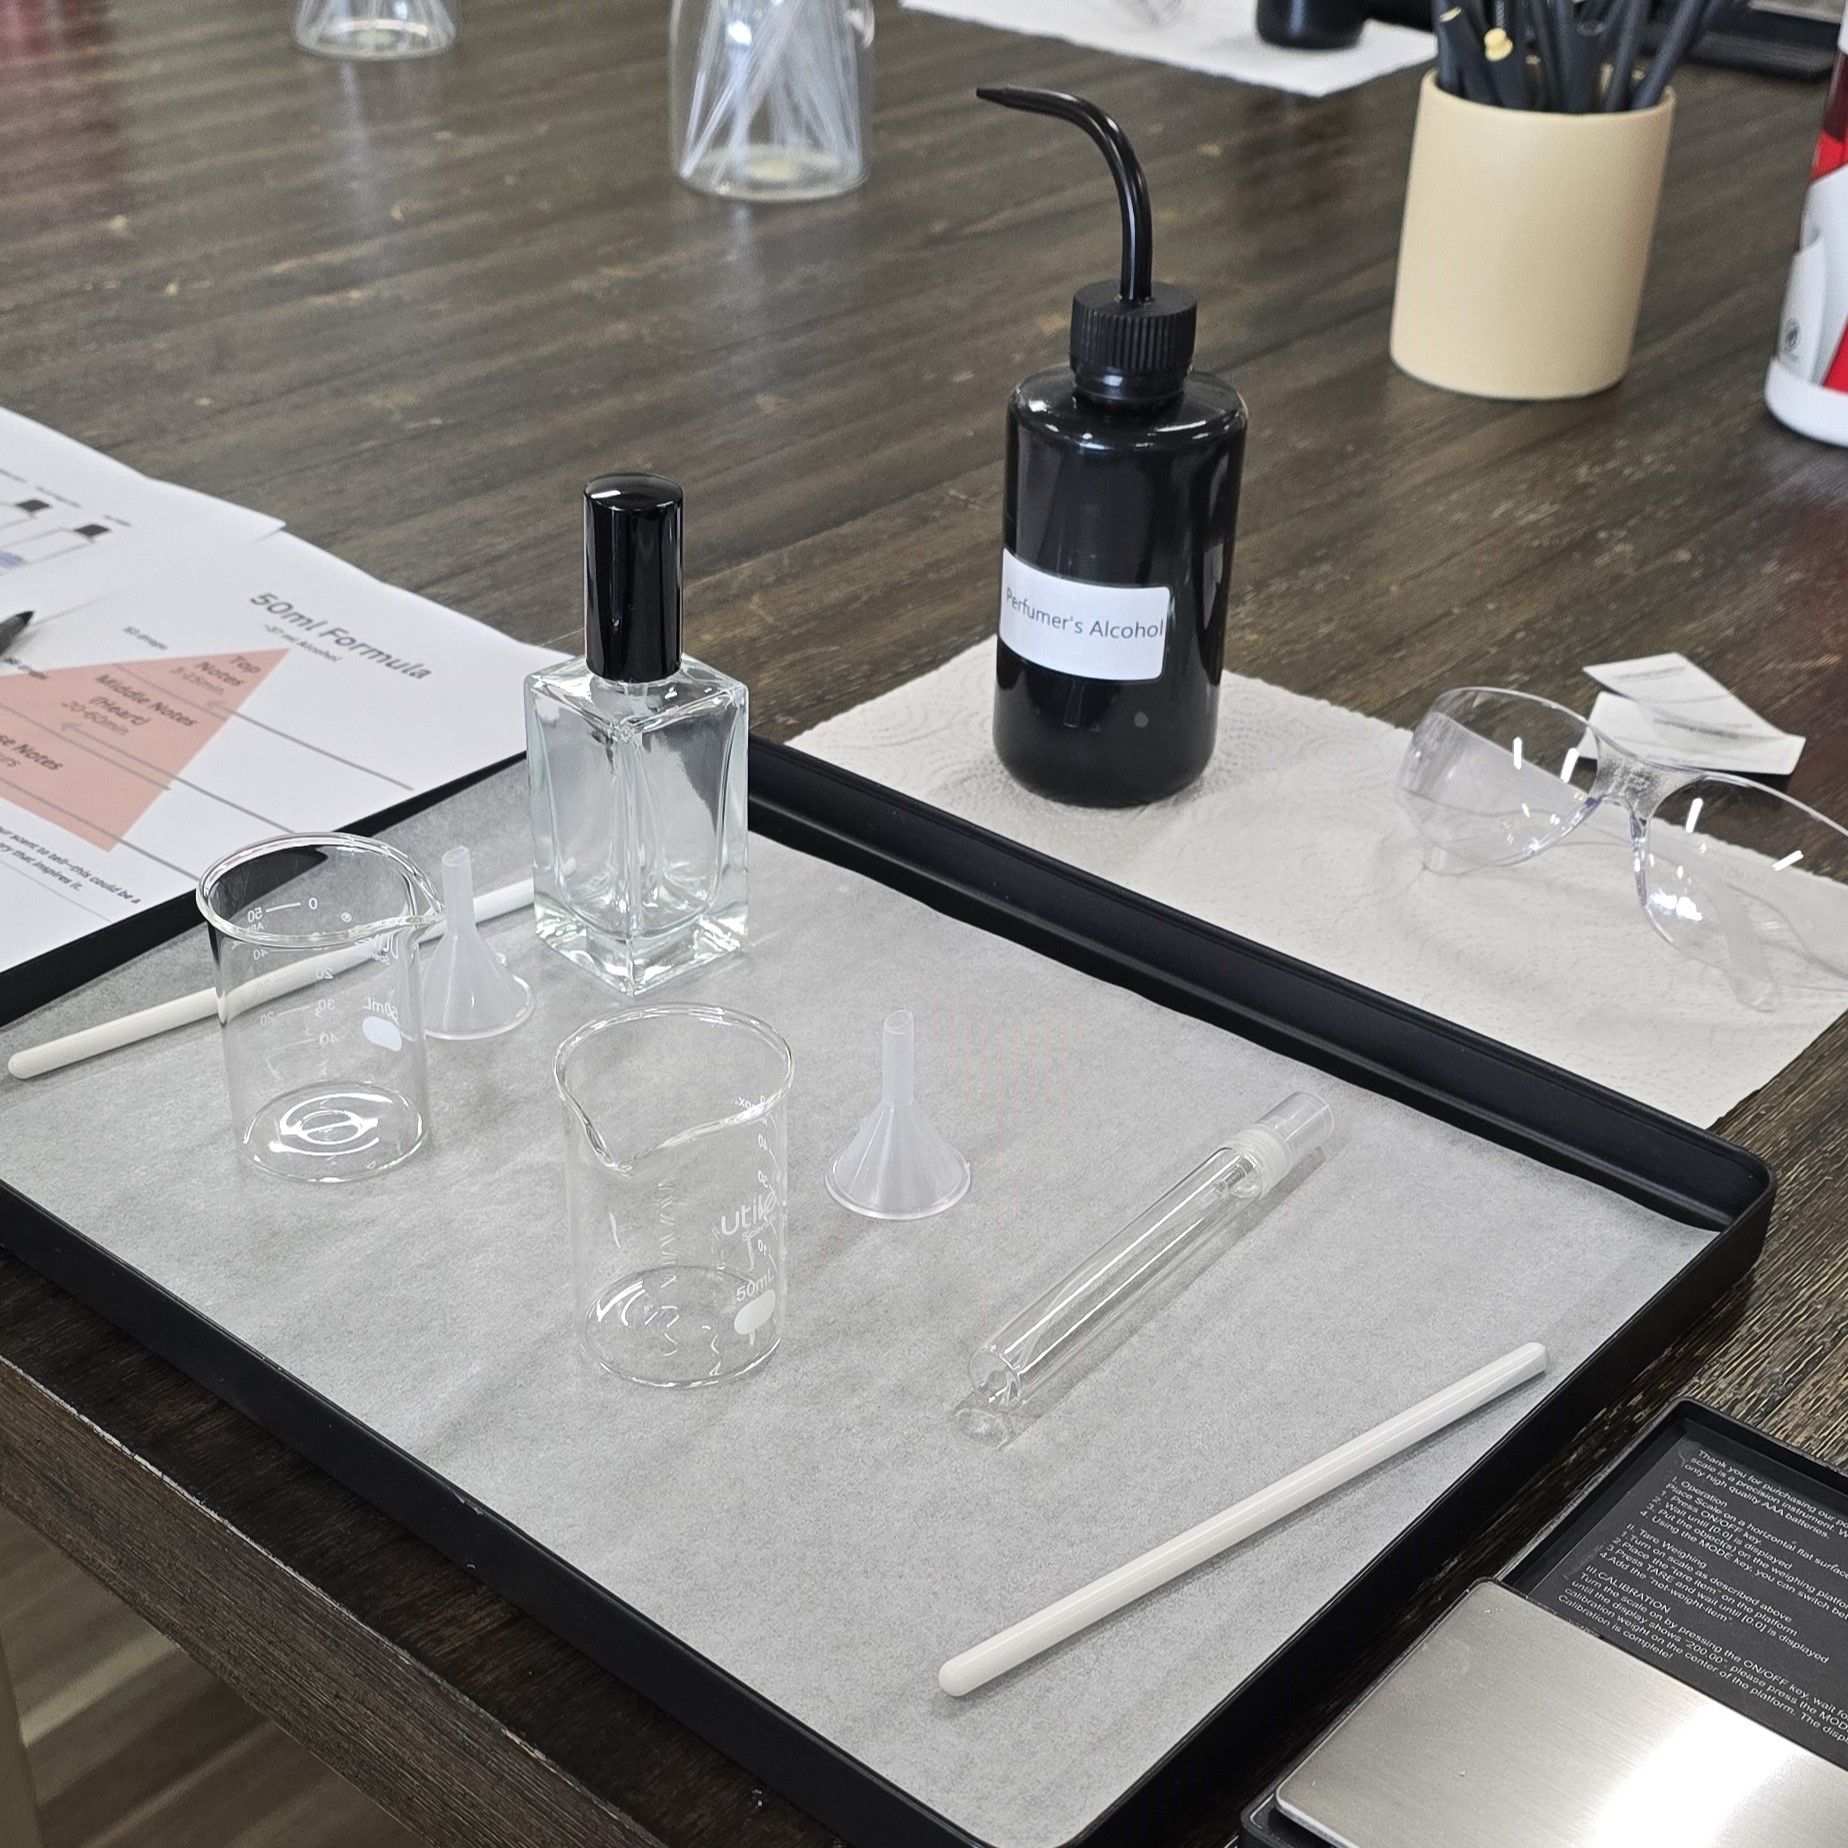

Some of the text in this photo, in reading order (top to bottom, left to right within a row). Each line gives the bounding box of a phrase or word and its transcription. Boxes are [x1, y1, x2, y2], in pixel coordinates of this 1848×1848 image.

[250, 592, 432, 679] 50ml Formula
[1005, 587, 1164, 639] Perfumer's Alcohol
[196, 661, 245, 687] Notes
[229, 655, 262, 675] Top
[95, 674, 198, 727] Middle Notes
[13, 743, 64, 771] Notes
[1670, 1495, 1699, 1513] Press
[1700, 1510, 1744, 1533] ON/OFF
[1681, 1481, 1728, 1508] Operation
[1684, 1464, 1830, 1539] only high quality AAA batteries.
[1690, 1457, 1717, 1473] scale
[1717, 1470, 1727, 1478] is
[1735, 1480, 1781, 1504] precision
[1699, 1449, 1727, 1469] Thank
[1727, 1466, 1748, 1479] you
[1748, 1475, 1762, 1485] for
[1762, 1483, 1817, 1514] purchasing
[1817, 1510, 1837, 1522] our
[1639, 1528, 1660, 1544] Tare
[1662, 1540, 1708, 1570] Weighing
[1658, 1508, 1676, 1521] Put
[1676, 1518, 1693, 1530] the
[1693, 1528, 1737, 1553] object(s)
[1737, 1550, 1752, 1560] on
[1752, 1557, 1770, 1569] the
[1771, 1566, 1816, 1594] weighing
[1665, 1483, 1693, 1500] Place
[1694, 1497, 1723, 1514] Scale
[1723, 1512, 1737, 1522] on
[1746, 1523, 1797, 1552] horizontal
[1796, 1548, 1814, 1561] flat
[1665, 1502, 1687, 1517] Wait
[1687, 1514, 1710, 1528] until
[1733, 1537, 1743, 1545] is
[1743, 1543, 1793, 1570] displayed
[1630, 1567, 1647, 1580] the
[1651, 1515, 1680, 1534] Using
[1680, 1531, 1698, 1543] the
[1698, 1539, 1734, 1560] MODE
[1754, 1569, 1775, 1582] you
[1776, 1580, 1796, 1593] can
[1797, 1590, 1830, 1611] switch
[1652, 1548, 1667, 1559] on
[1667, 1555, 1694, 1572] scale
[1694, 1570, 1709, 1580] as
[1709, 1577, 1760, 1606] described
[1760, 1603, 1793, 1623] above
[1652, 1558, 1669, 1570] the
[1721, 1594, 1736, 1604] on
[1736, 1601, 1754, 1613] the
[1754, 1611, 1798, 1637] platform
[1558, 1594, 1674, 1660] Calibration is complete!
[1580, 1571, 1602, 1589] Turn
[1603, 1586, 1620, 1598] the
[1620, 1595, 1648, 1613] scale
[1649, 1611, 1663, 1621] on
[1663, 1617, 1678, 1629] by
[1677, 1626, 1723, 1654] pressing
[1723, 1649, 1742, 1663] the
[1743, 1660, 1790, 1686] ON/OFF
[1813, 1697, 1836, 1713] wait
[1646, 1563, 1676, 1583] TARE
[1675, 1581, 1697, 1594] and
[1697, 1591, 1719, 1606] wait
[1718, 1603, 1743, 1618] until
[1740, 1614, 1767, 1632] [0.0]
[1766, 1627, 1777, 1637] is
[1778, 1634, 1830, 1664] displayed
[1564, 1588, 1616, 1618] calibration
[1616, 1615, 1651, 1636] weight
[1650, 1634, 1665, 1645] on
[1666, 1641, 1683, 1654] the
[1684, 1652, 1719, 1673] center
[1719, 1670, 1733, 1680] of
[1731, 1676, 1749, 1690] the
[1749, 1687, 1796, 1716] platform.
[1800, 1711, 1821, 1728] The
[1571, 1580, 1595, 1595] until
[1594, 1592, 1611, 1604] the
[1611, 1602, 1648, 1624] display
[1648, 1621, 1682, 1642] shows
[1729, 1665, 1766, 1687] please
[1766, 1685, 1798, 1704] press
[1799, 1701, 1817, 1714] the
[1818, 1711, 1848, 1733] MOD
